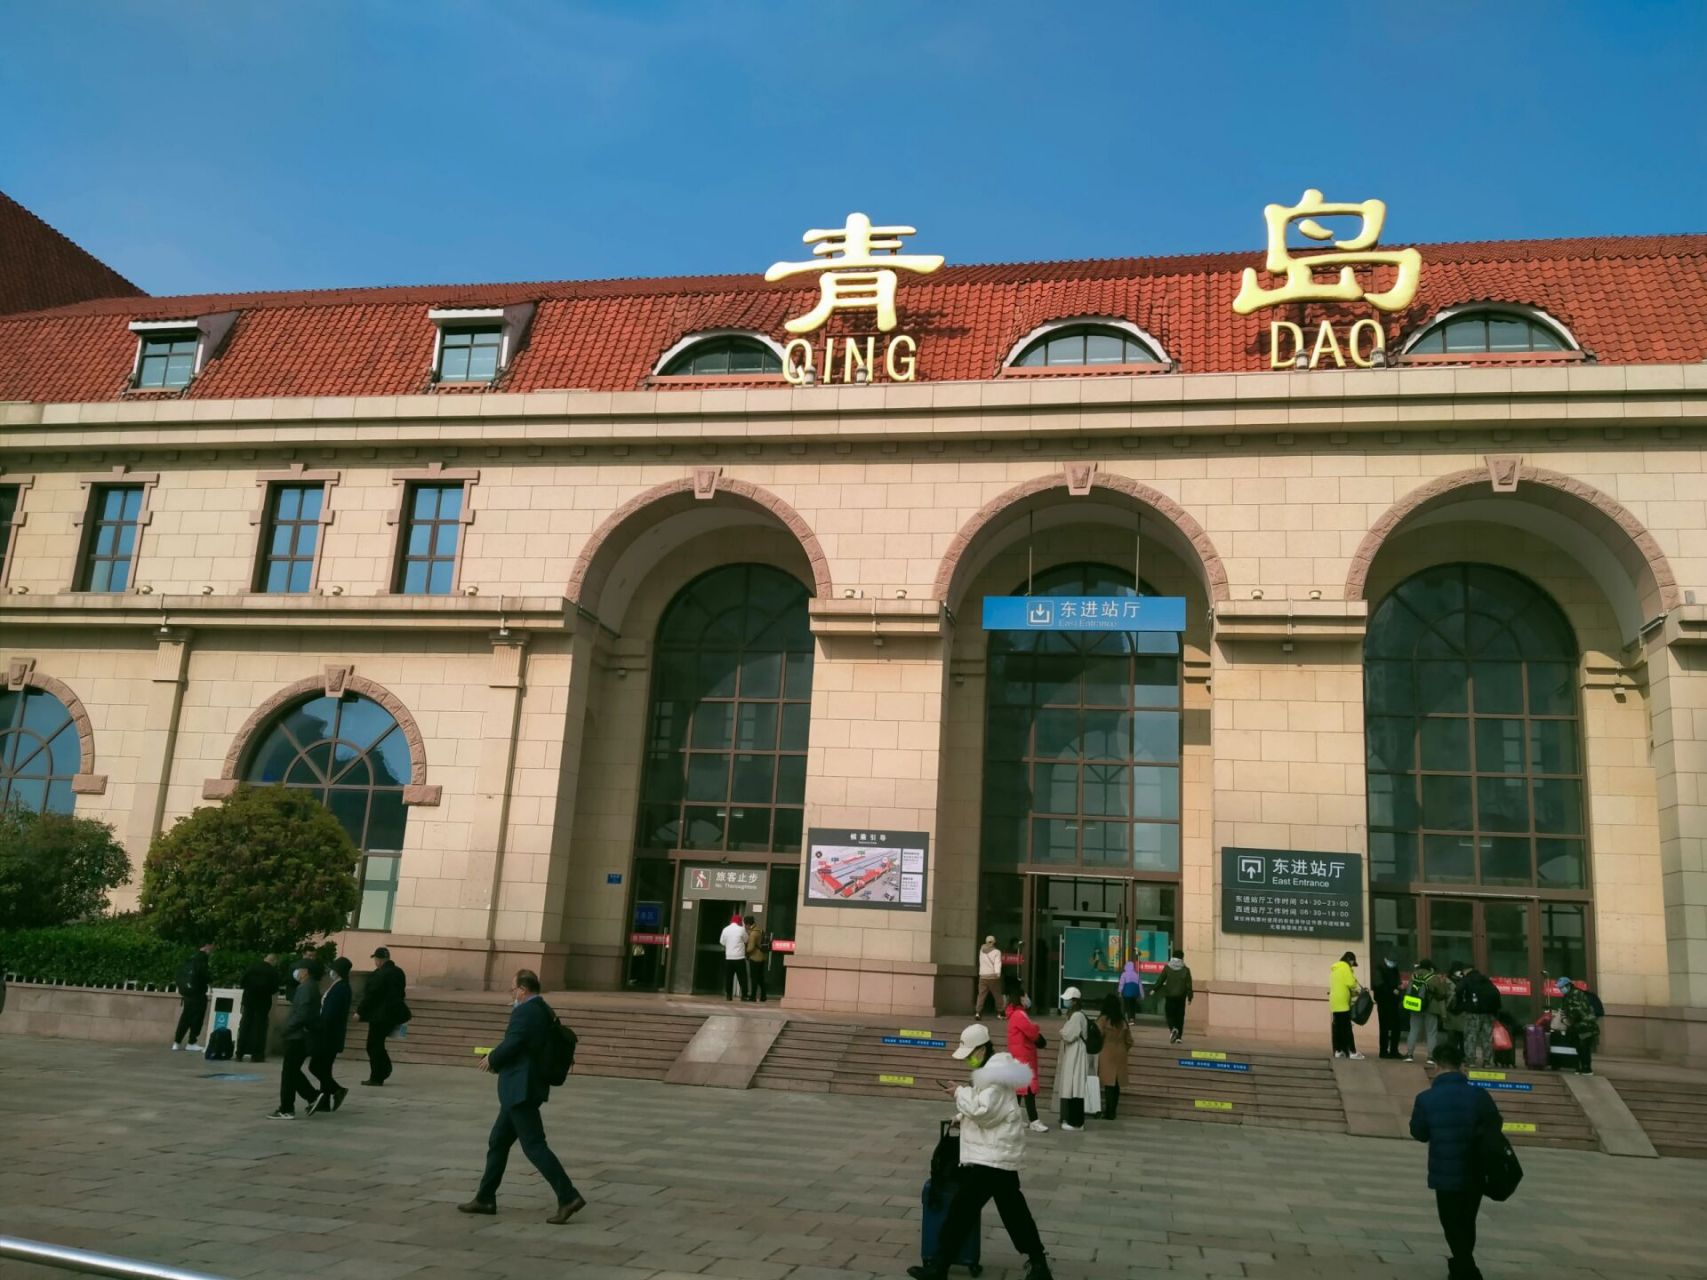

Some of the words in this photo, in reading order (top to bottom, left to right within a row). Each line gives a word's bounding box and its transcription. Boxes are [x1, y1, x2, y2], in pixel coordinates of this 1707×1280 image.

[765, 212, 945, 333] 青
[1233, 189, 1422, 315] 岛
[782, 335, 916, 385] QING
[1271, 319, 1386, 369] DAO
[1060, 601, 1141, 619] 东进站厅
[1272, 858, 1346, 878] 东进站厅
[716, 871, 759, 884] 旅客止步
[1272, 877, 1291, 886] East
[1293, 878, 1330, 888] Entrance
[1235, 895, 1297, 906] 东进站厅工作时间
[1235, 905, 1297, 916] 西进站厅工作时间
